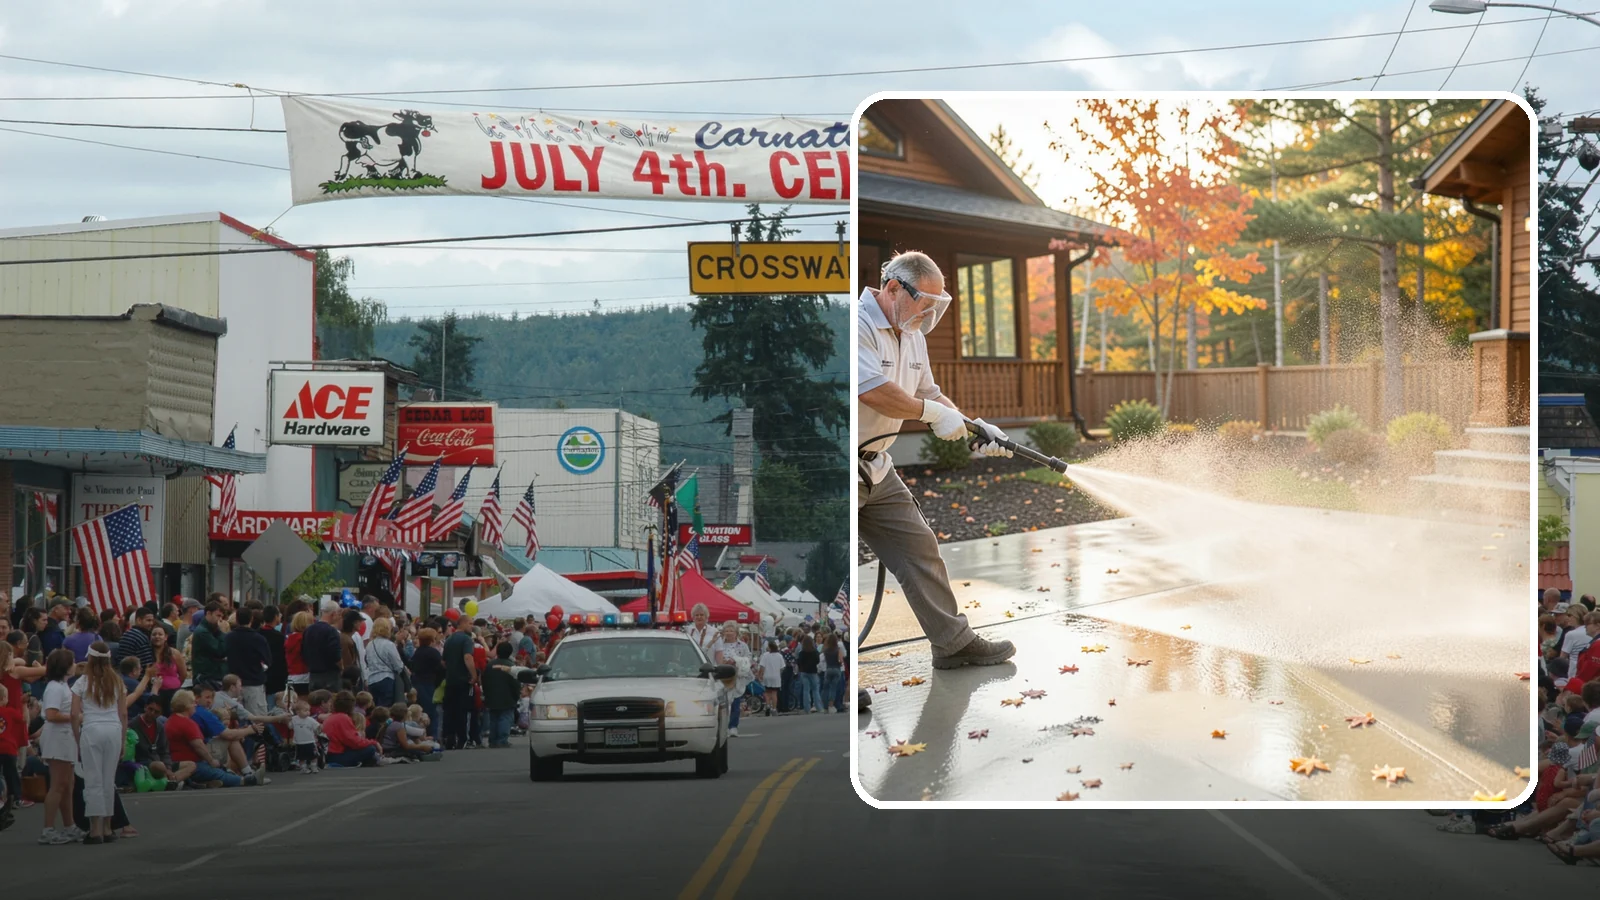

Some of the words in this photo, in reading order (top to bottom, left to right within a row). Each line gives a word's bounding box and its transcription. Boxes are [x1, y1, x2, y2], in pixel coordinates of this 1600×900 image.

[481, 141, 605, 193] JULY
[632, 150, 747, 198] 4th.
[697, 254, 850, 280] CROSSWA
[283, 380, 374, 420] ACE
[405, 409, 452, 422] CEDAR
[461, 409, 486, 422] LOG
[284, 421, 371, 436] Hardware
[416, 428, 477, 447] Coca-Cola
[95, 485, 124, 494] Vincent
[126, 485, 136, 494] de
[137, 486, 155, 495] Paul
[698, 535, 730, 543] GLASS
